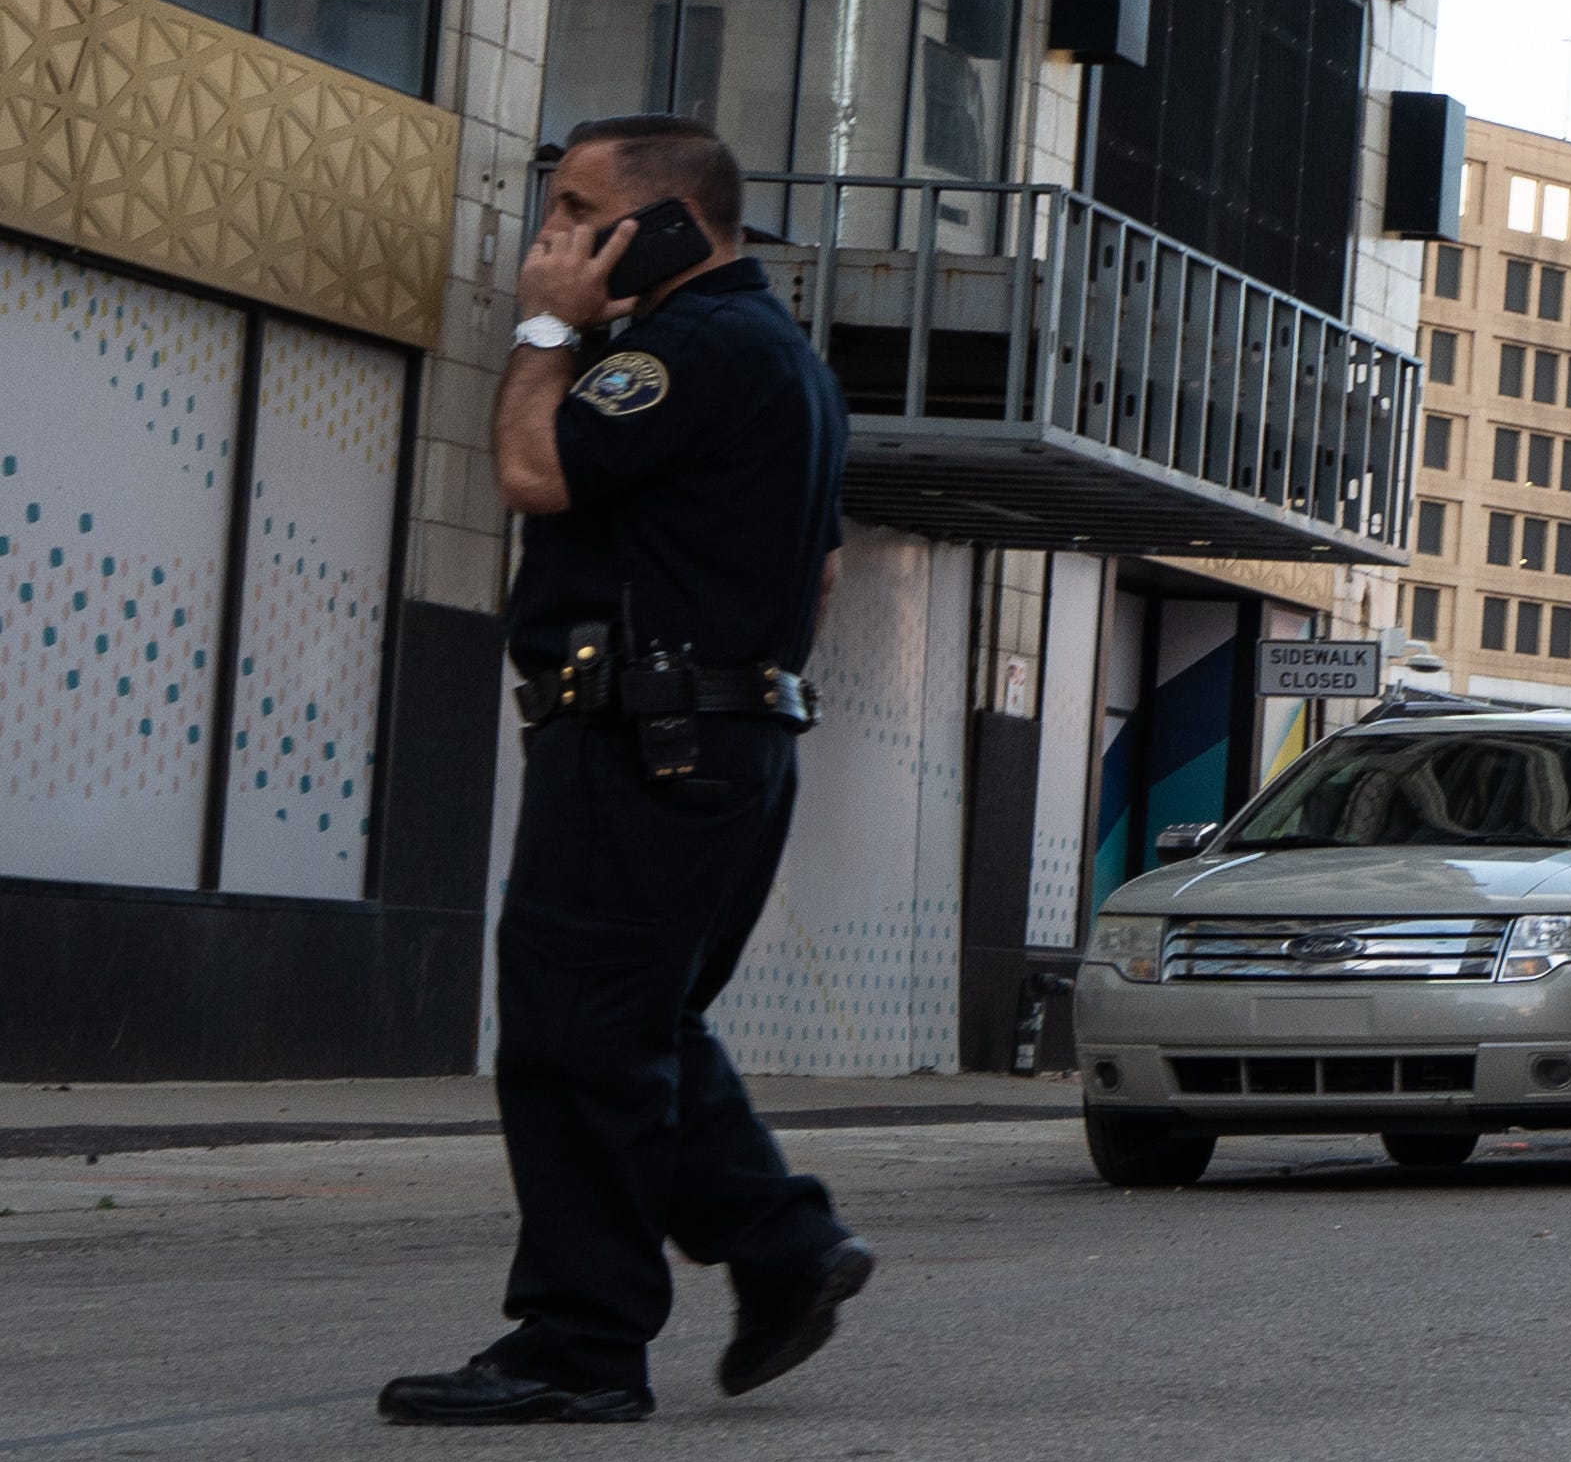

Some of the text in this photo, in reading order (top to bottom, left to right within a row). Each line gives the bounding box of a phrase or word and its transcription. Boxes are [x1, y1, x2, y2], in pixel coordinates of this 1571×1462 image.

[1269, 648, 1368, 667] SIDEWALK
[1279, 671, 1357, 689] CLOSED
[1300, 940, 1349, 954] Ford
